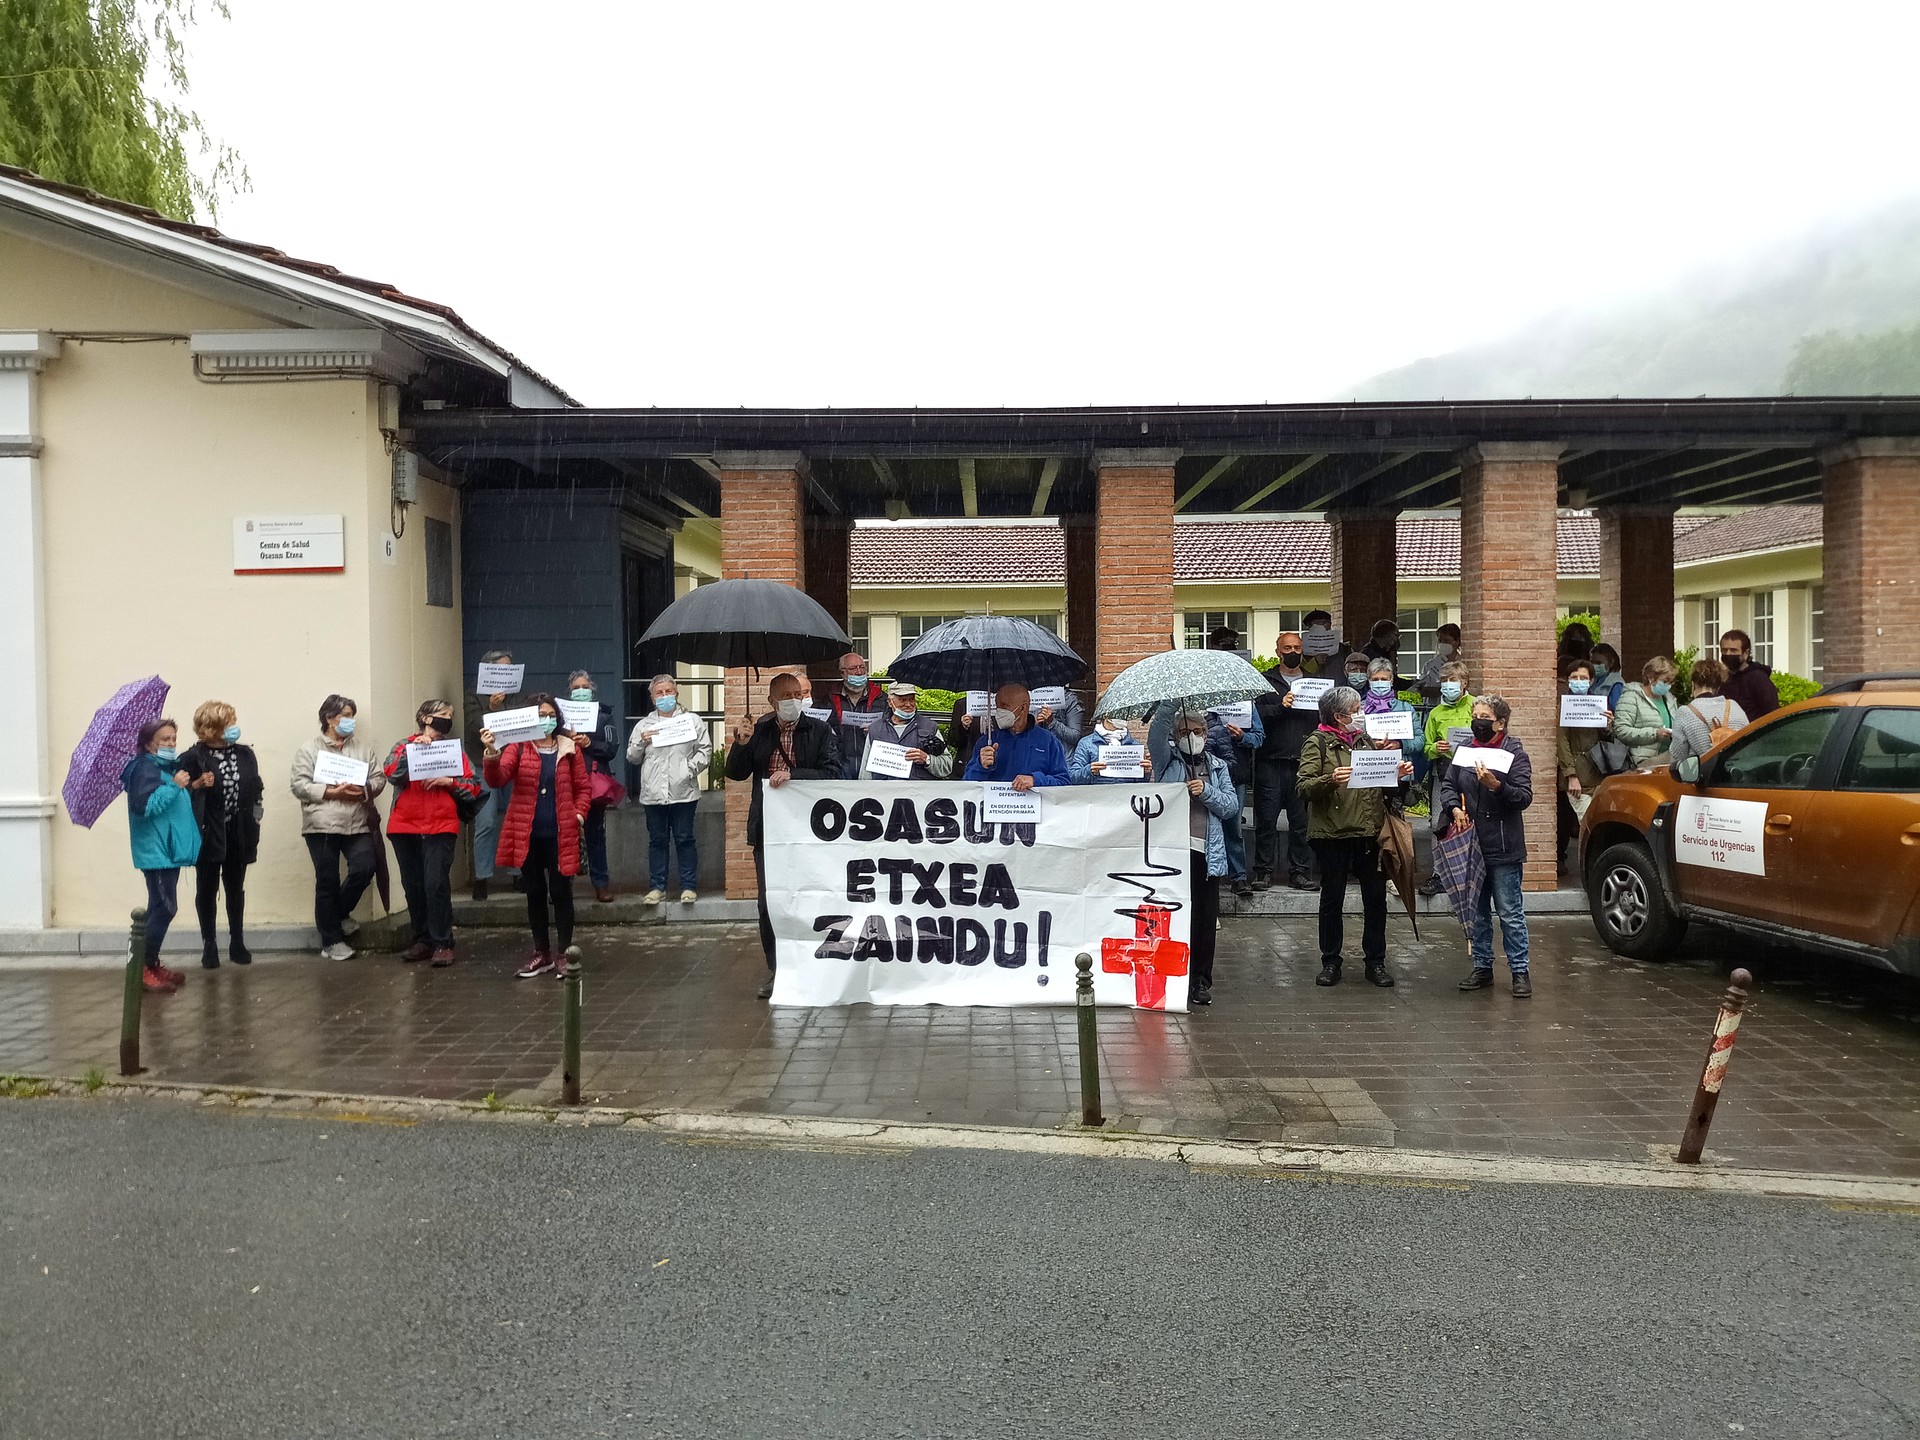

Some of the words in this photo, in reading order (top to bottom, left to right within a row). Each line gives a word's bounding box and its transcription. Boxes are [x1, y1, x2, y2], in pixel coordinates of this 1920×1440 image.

[292, 540, 310, 548] Salud
[385, 540, 392, 557] 6
[260, 552, 284, 560] Osasun
[1682, 834, 1708, 846] Servicio
[1709, 838, 1718, 848] de
[1720, 838, 1756, 853] Urgencias
[1711, 850, 1725, 863] 112
[846, 858, 1020, 910] ETXEA
[812, 910, 1052, 988] ZAINDU!
